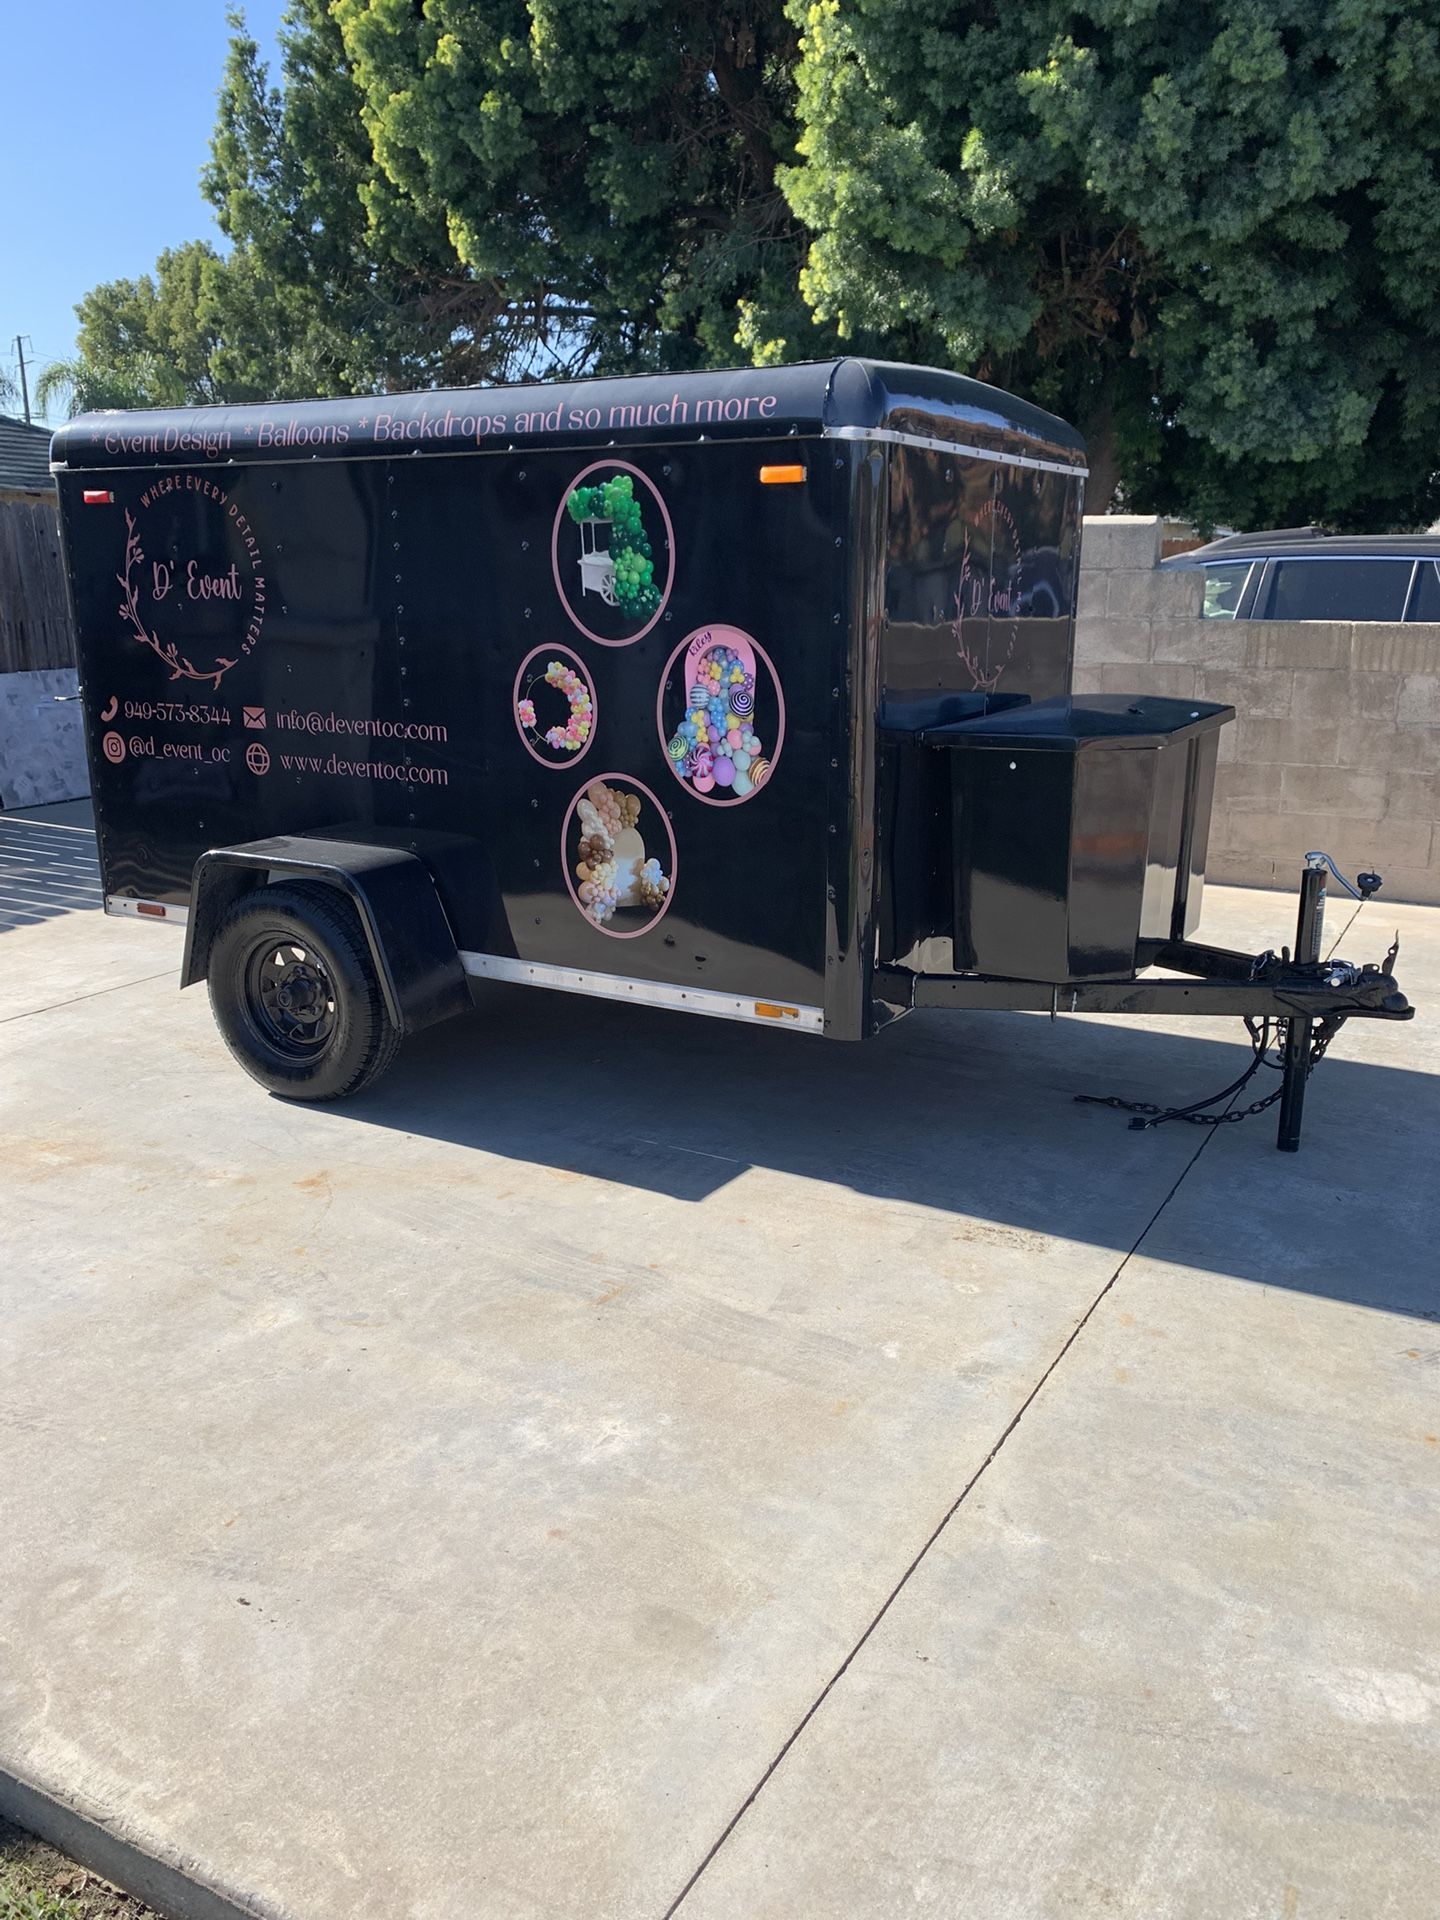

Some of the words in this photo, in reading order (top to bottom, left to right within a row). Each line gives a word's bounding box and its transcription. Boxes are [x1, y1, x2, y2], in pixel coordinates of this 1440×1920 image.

[105, 429, 159, 455] Event
[163, 425, 232, 459] Design
[257, 419, 350, 449] Balloons
[373, 409, 506, 446] Backdrops
[513, 401, 564, 434] and
[568, 407, 602, 430] so
[609, 393, 688, 428] much
[695, 394, 777, 422] more
[139, 474, 183, 509] WHERE
[186, 474, 229, 506] EVERY
[228, 503, 262, 571] DETAIL
[152, 558, 175, 601] D'
[186, 558, 243, 601] Event
[240, 576, 266, 656] MATTERS
[124, 700, 232, 726] 949-573-8344
[275, 708, 448, 743] info@deventoc.com
[128, 735, 232, 765] @d_event_oc
[279, 752, 449, 786] www.deventoc.com
